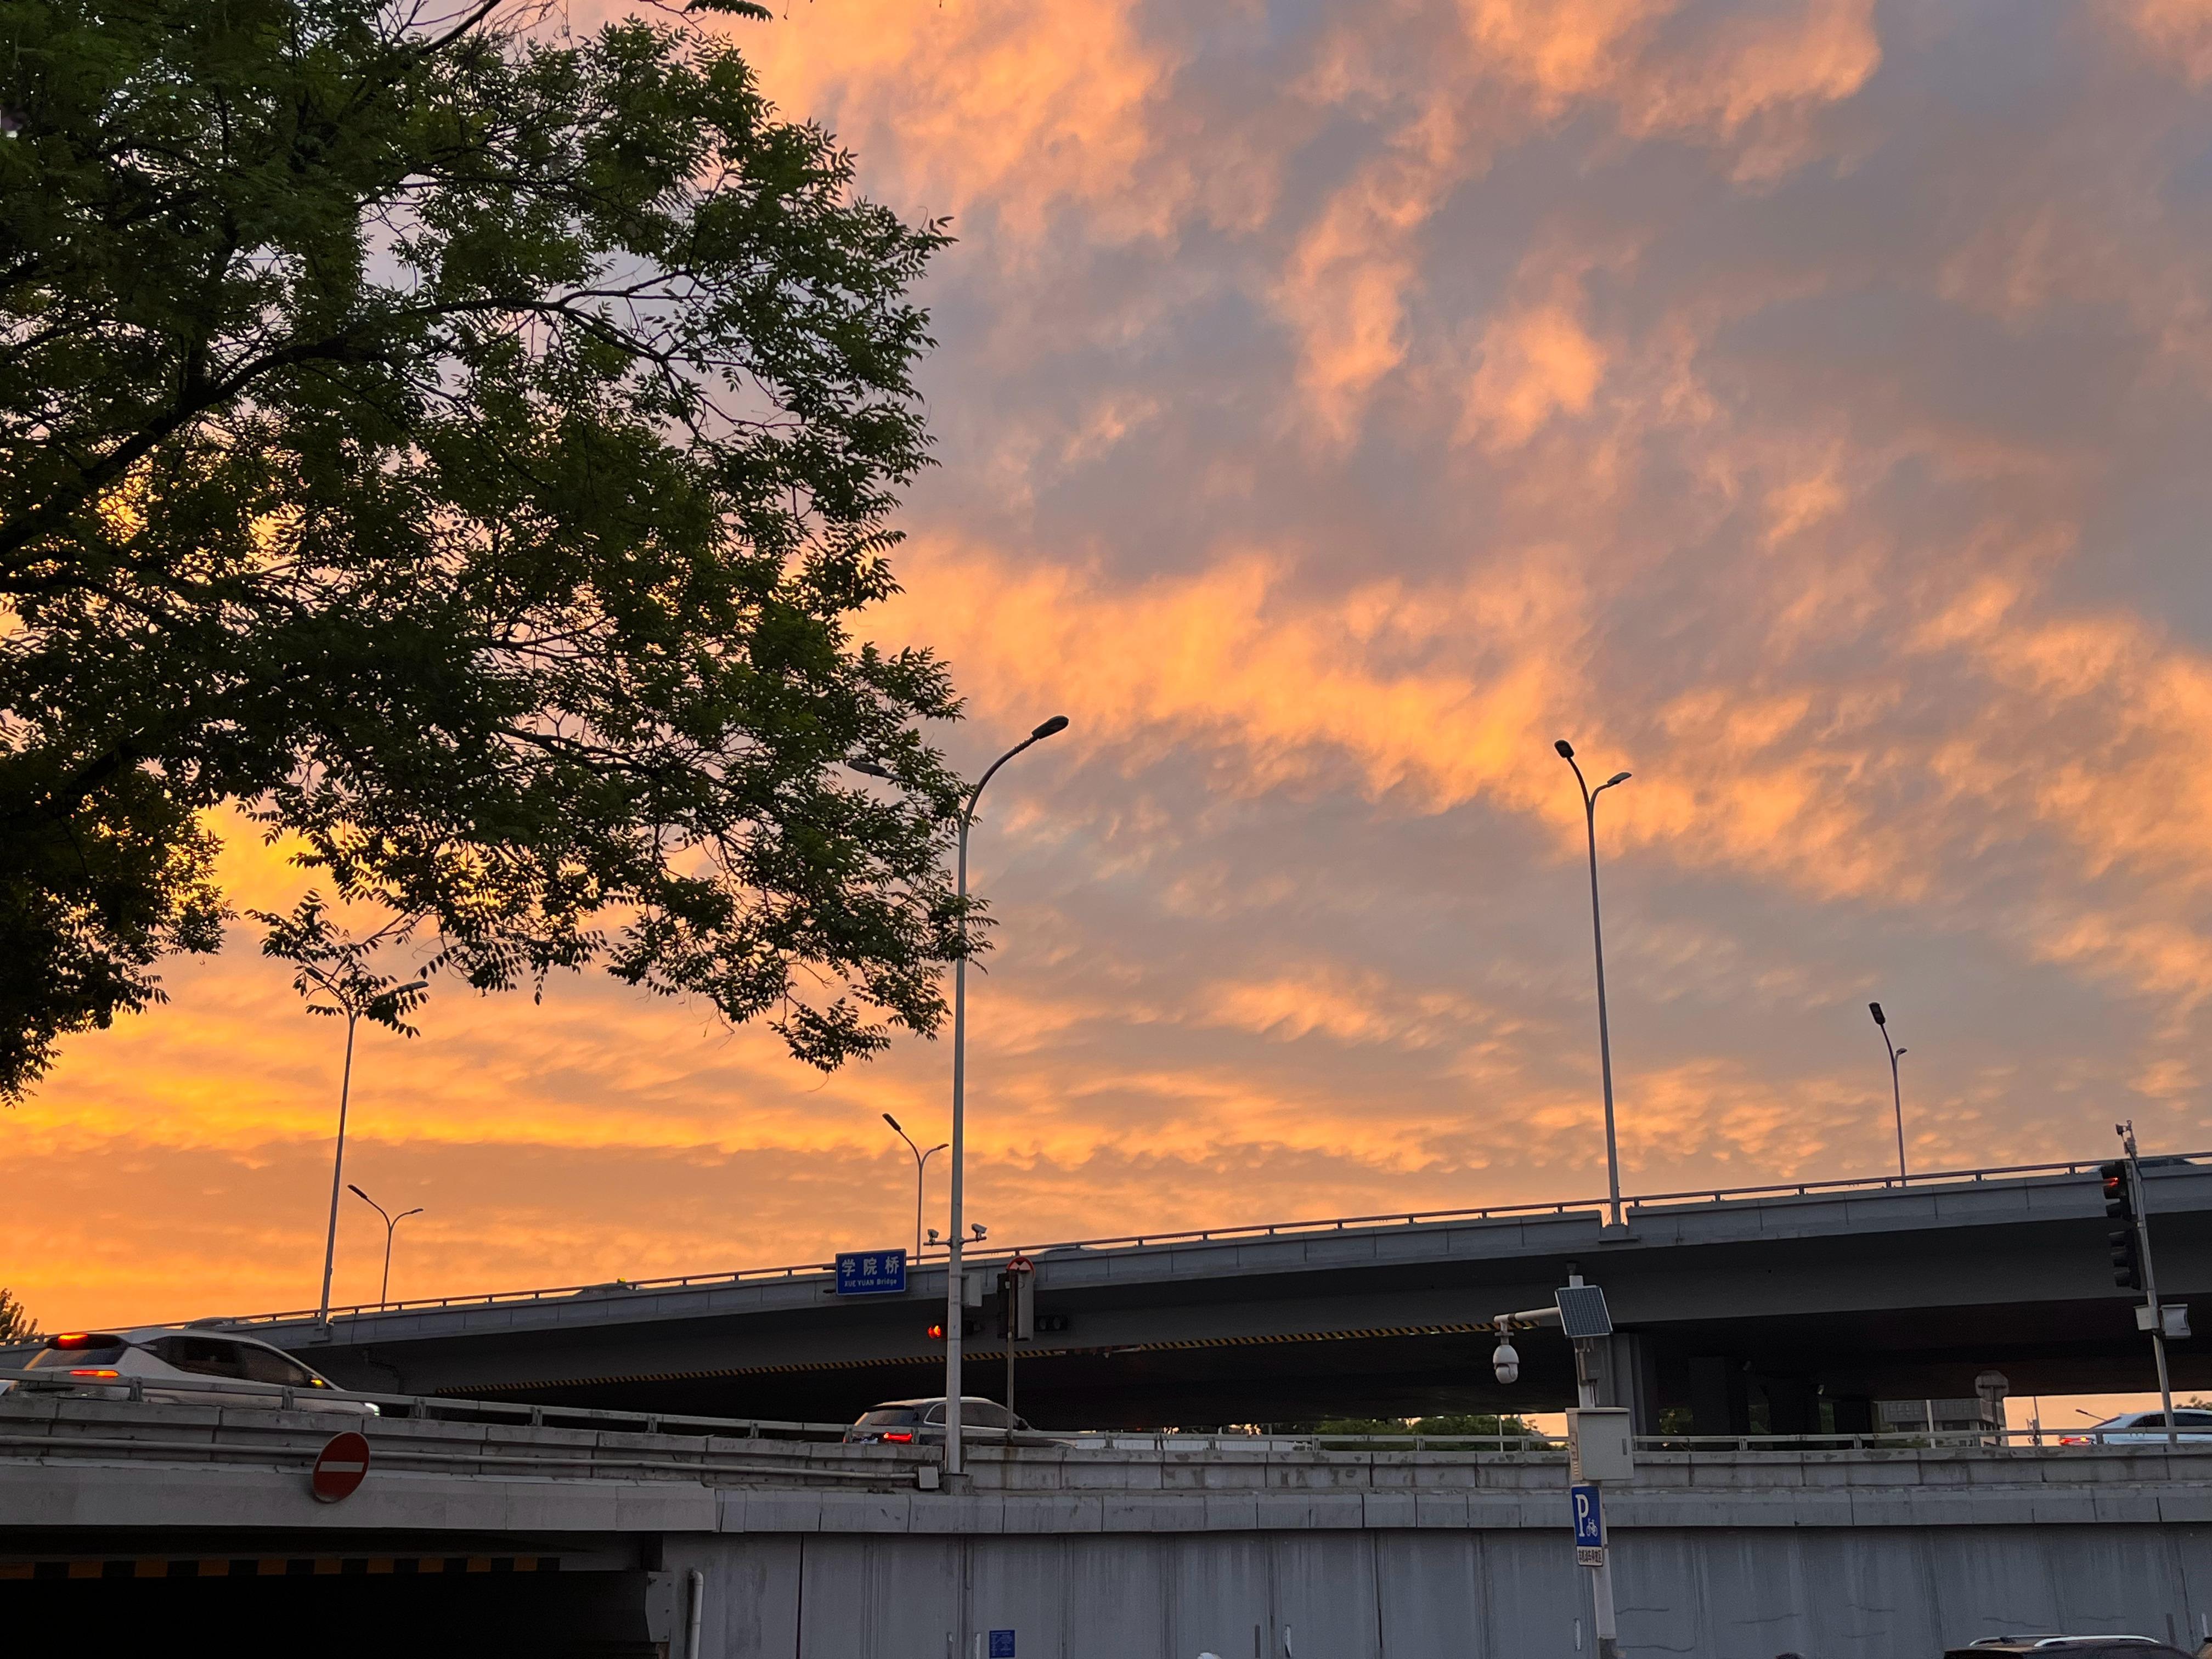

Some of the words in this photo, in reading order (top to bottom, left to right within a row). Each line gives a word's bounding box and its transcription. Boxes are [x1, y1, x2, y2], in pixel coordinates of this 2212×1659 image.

[842, 1256, 900, 1277] 学院桥
[877, 1278, 897, 1286] Bridge
[1575, 1494, 1589, 1537] P
